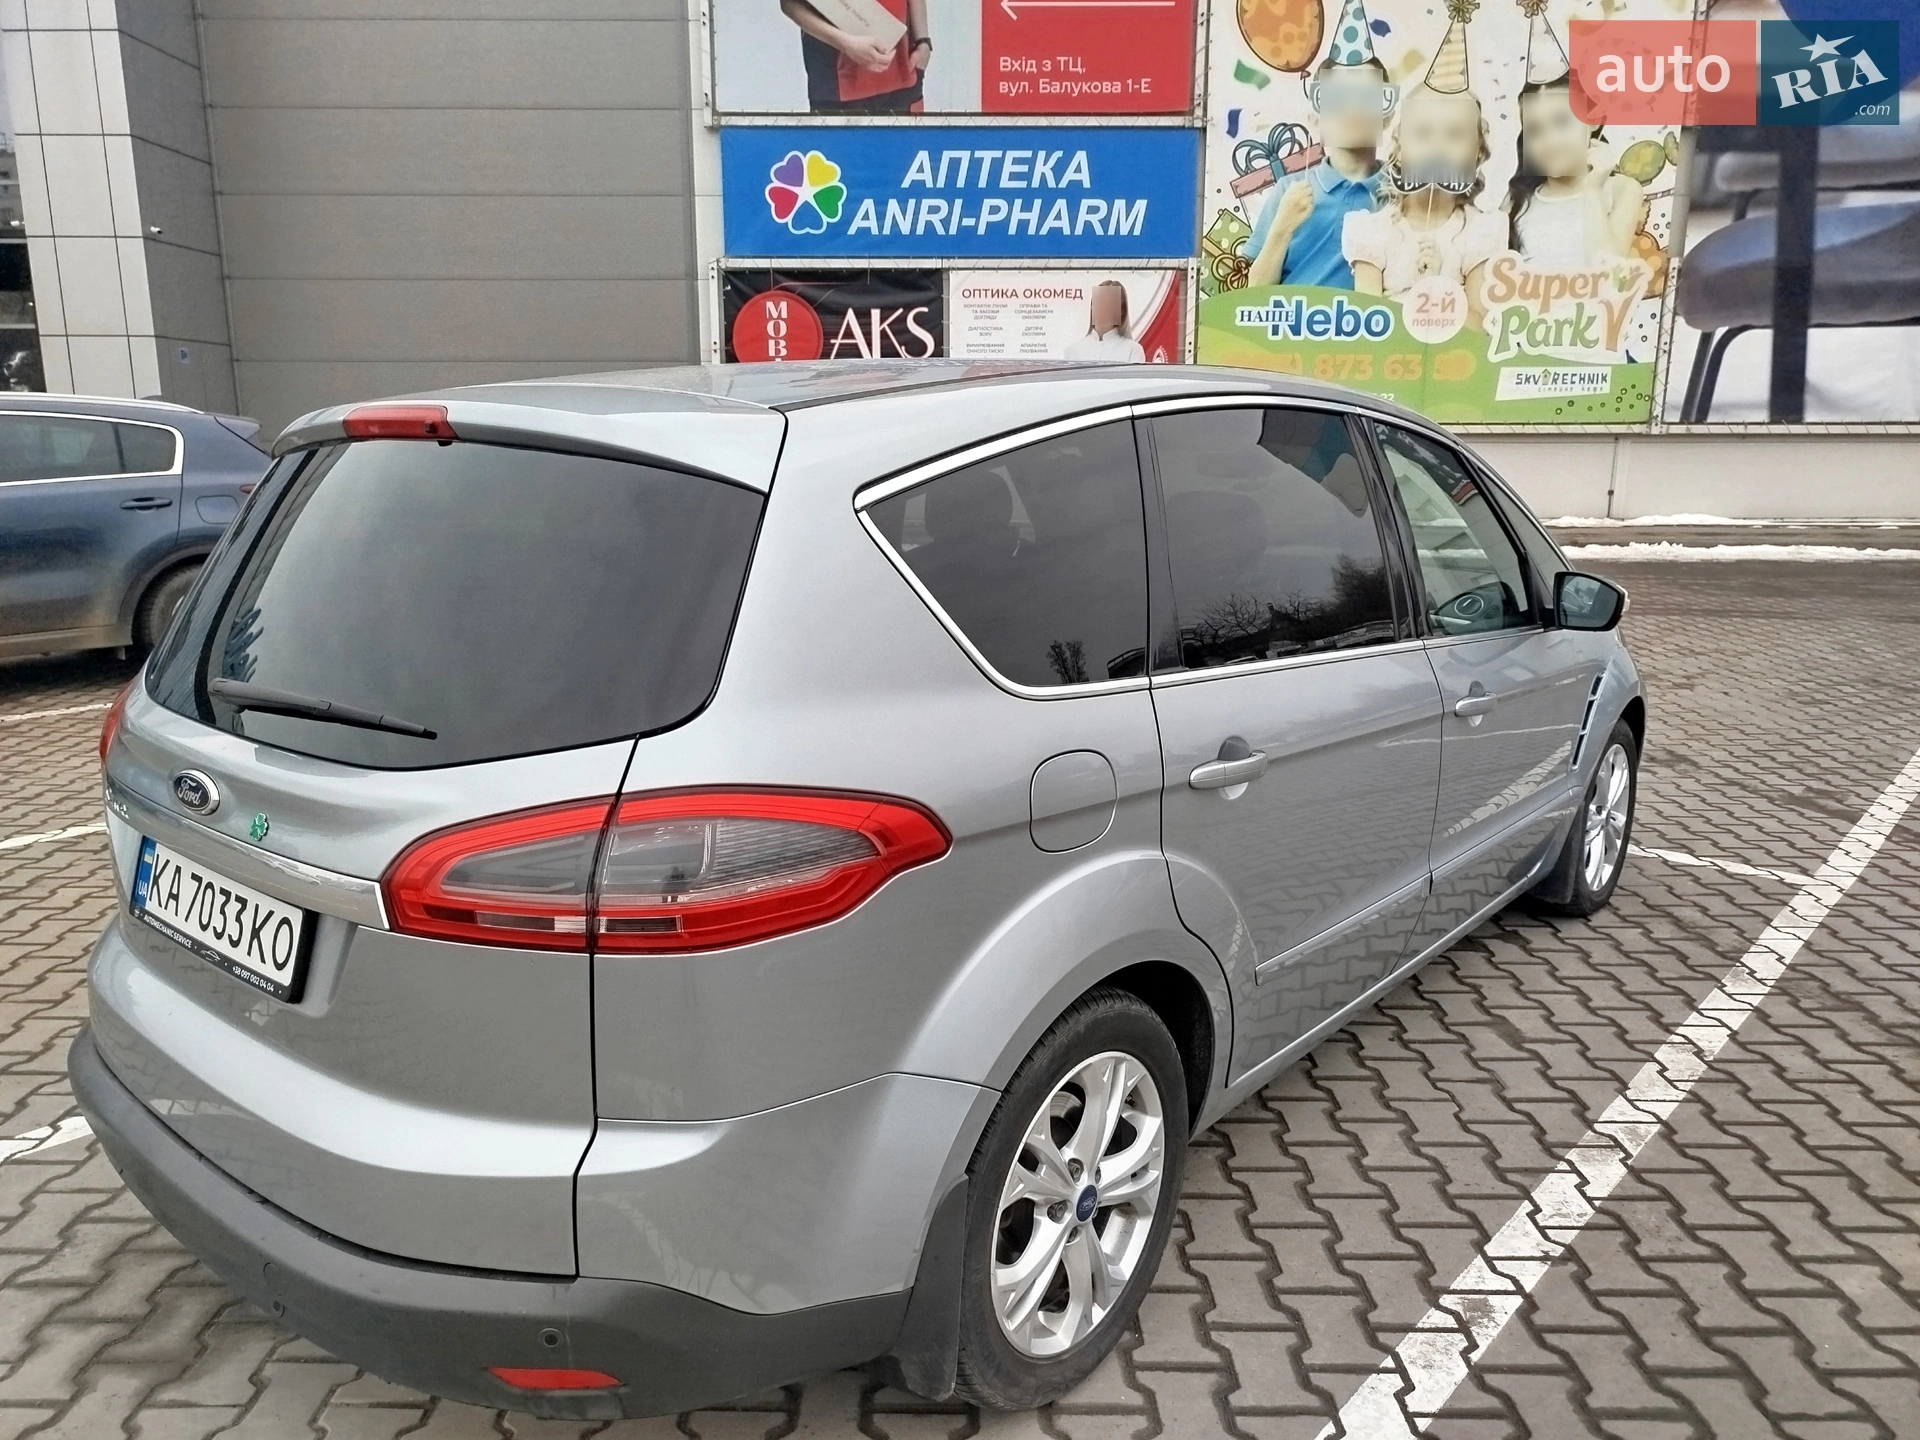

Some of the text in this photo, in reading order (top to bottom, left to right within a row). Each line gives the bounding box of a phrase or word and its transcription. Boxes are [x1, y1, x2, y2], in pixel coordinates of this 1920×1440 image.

[1000, 56, 1087, 74] Вхід з ТЦ,
[999, 78, 1152, 97] вул. Балукова 1-Е
[900, 150, 1091, 189] АПТЕКА
[847, 198, 1149, 236] ANRI-PHARM
[961, 288, 1084, 300] ОПТИКА ОКОМЕД
[1487, 257, 1610, 316] Super
[1239, 309, 1295, 323] НАШЕ
[1271, 299, 1391, 338] Nebo
[1412, 317, 1456, 328] поверх
[1494, 301, 1600, 355] Park
[830, 306, 936, 359] AKS
[1313, 353, 1373, 381] 873
[1383, 353, 1423, 381] 63
[177, 777, 203, 805] Ford
[138, 883, 148, 896] UA
